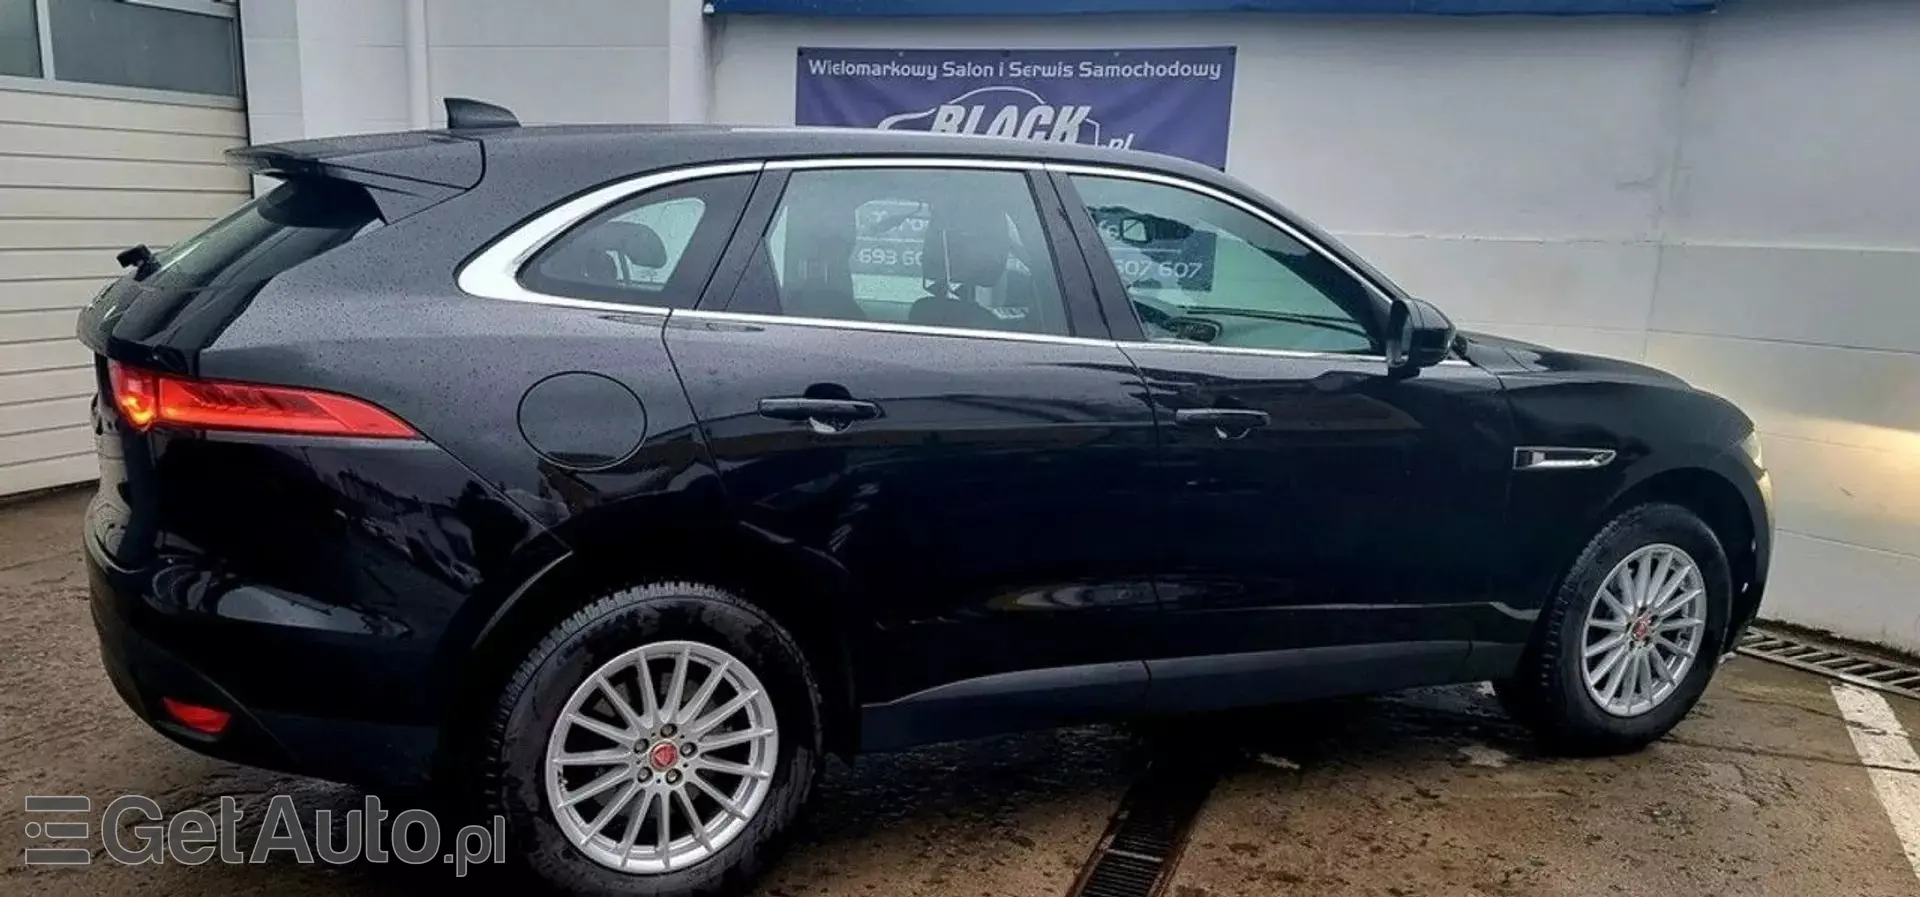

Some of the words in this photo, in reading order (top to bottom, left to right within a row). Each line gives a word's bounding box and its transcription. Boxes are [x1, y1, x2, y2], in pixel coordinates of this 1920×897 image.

[808, 59, 938, 81] Wielomarkowy
[942, 61, 994, 77] Salon
[1009, 61, 1074, 77] Serwis
[1079, 60, 1222, 81] Samochodowy
[929, 104, 1092, 145] BLACK
[858, 248, 898, 265] 693
[1159, 260, 1203, 279] 607
